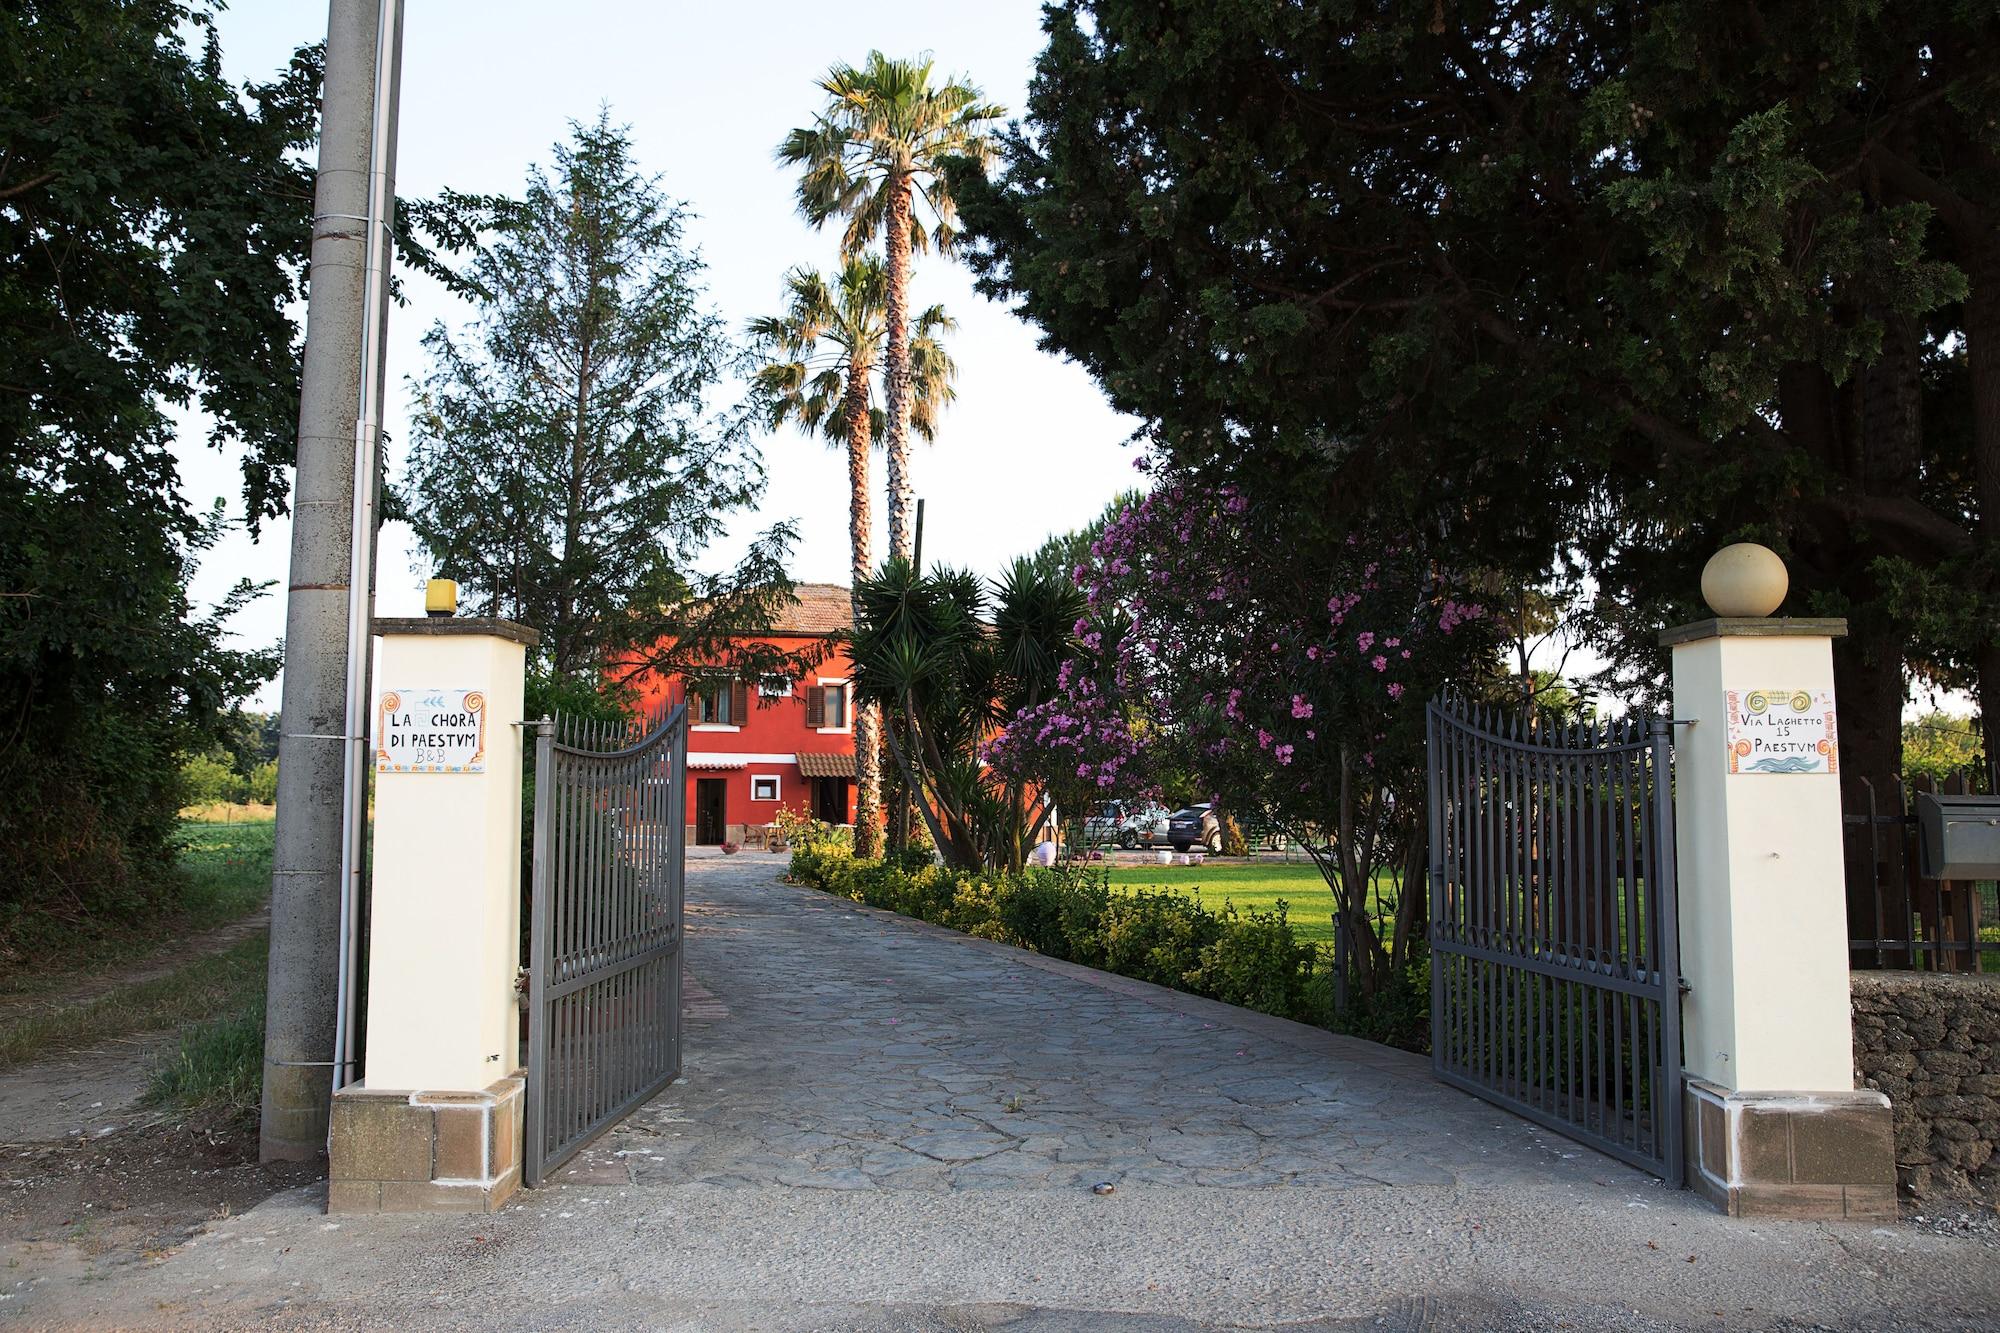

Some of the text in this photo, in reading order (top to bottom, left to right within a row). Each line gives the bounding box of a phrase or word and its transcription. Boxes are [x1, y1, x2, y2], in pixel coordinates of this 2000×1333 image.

[392, 713, 476, 727] LA CHORA
[1776, 726, 1790, 737] 15
[391, 734, 476, 748] DI PAESTVM
